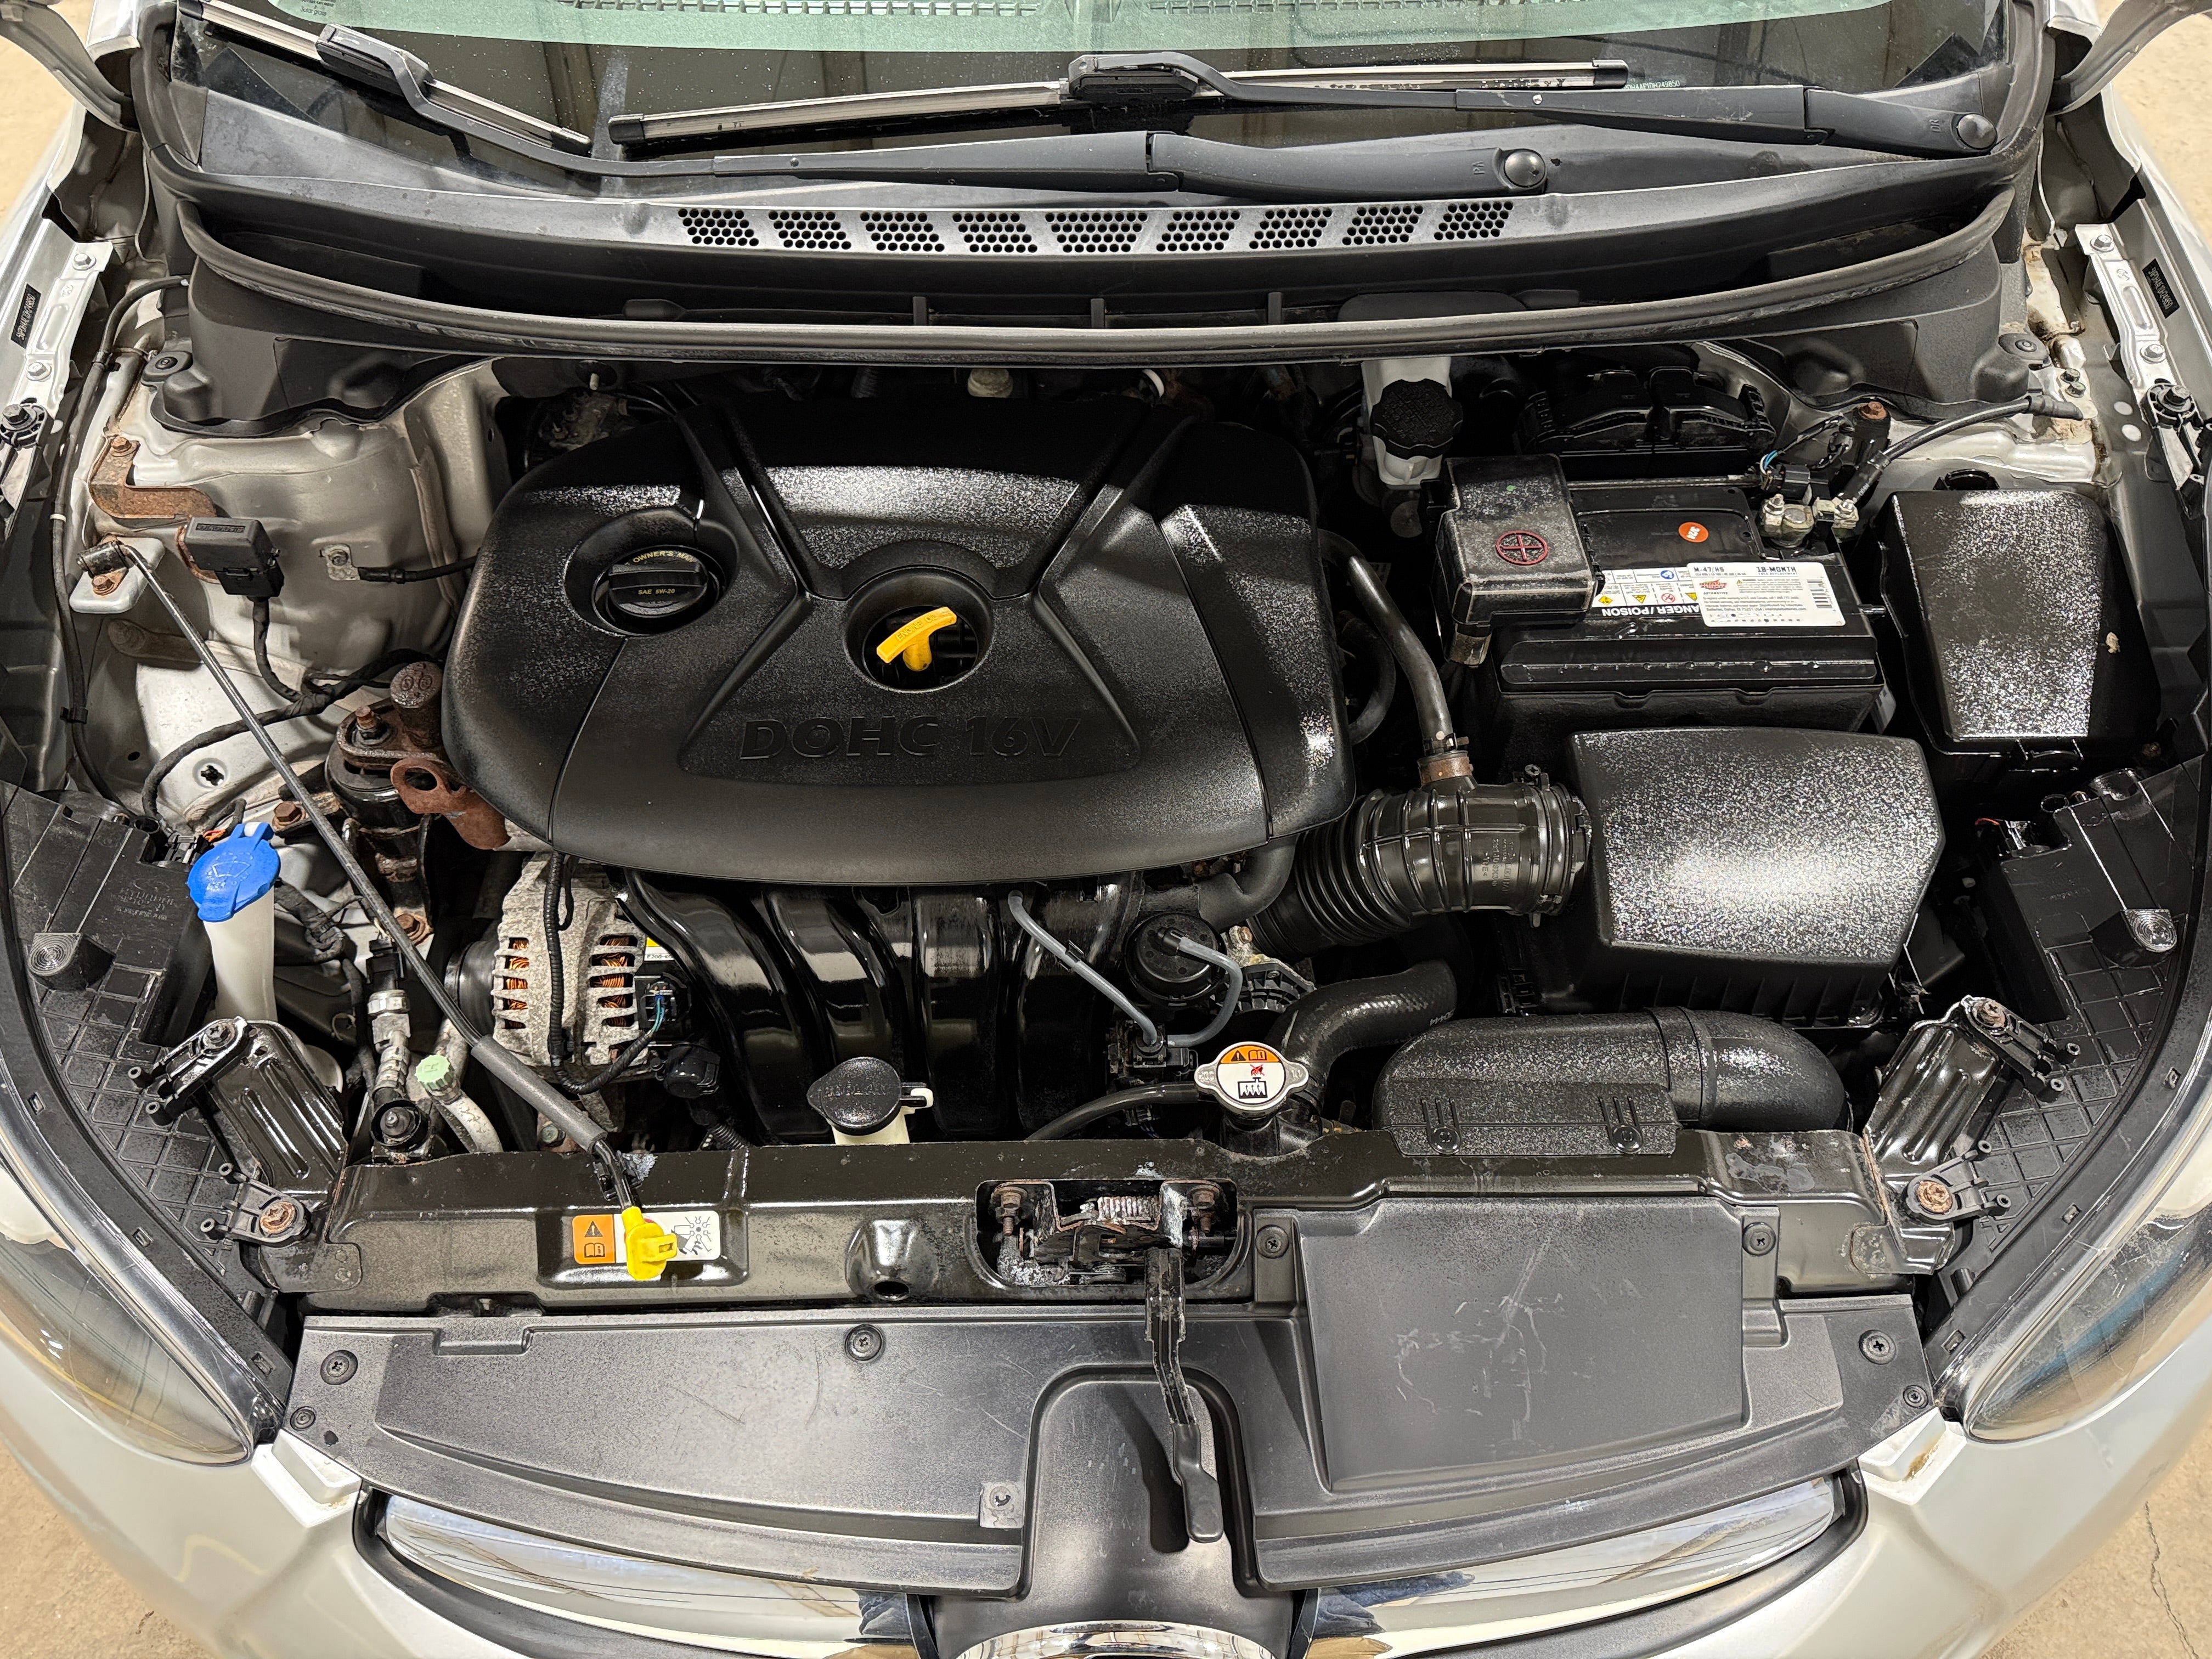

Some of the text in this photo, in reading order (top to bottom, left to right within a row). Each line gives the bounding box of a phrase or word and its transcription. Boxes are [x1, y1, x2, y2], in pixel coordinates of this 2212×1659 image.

[633, 551, 697, 563] OWNER'S MAN
[1657, 605, 1700, 614] ANGER
[896, 614, 938, 641] ENGINE OIL
[740, 715, 1081, 759] DOHC 16V
